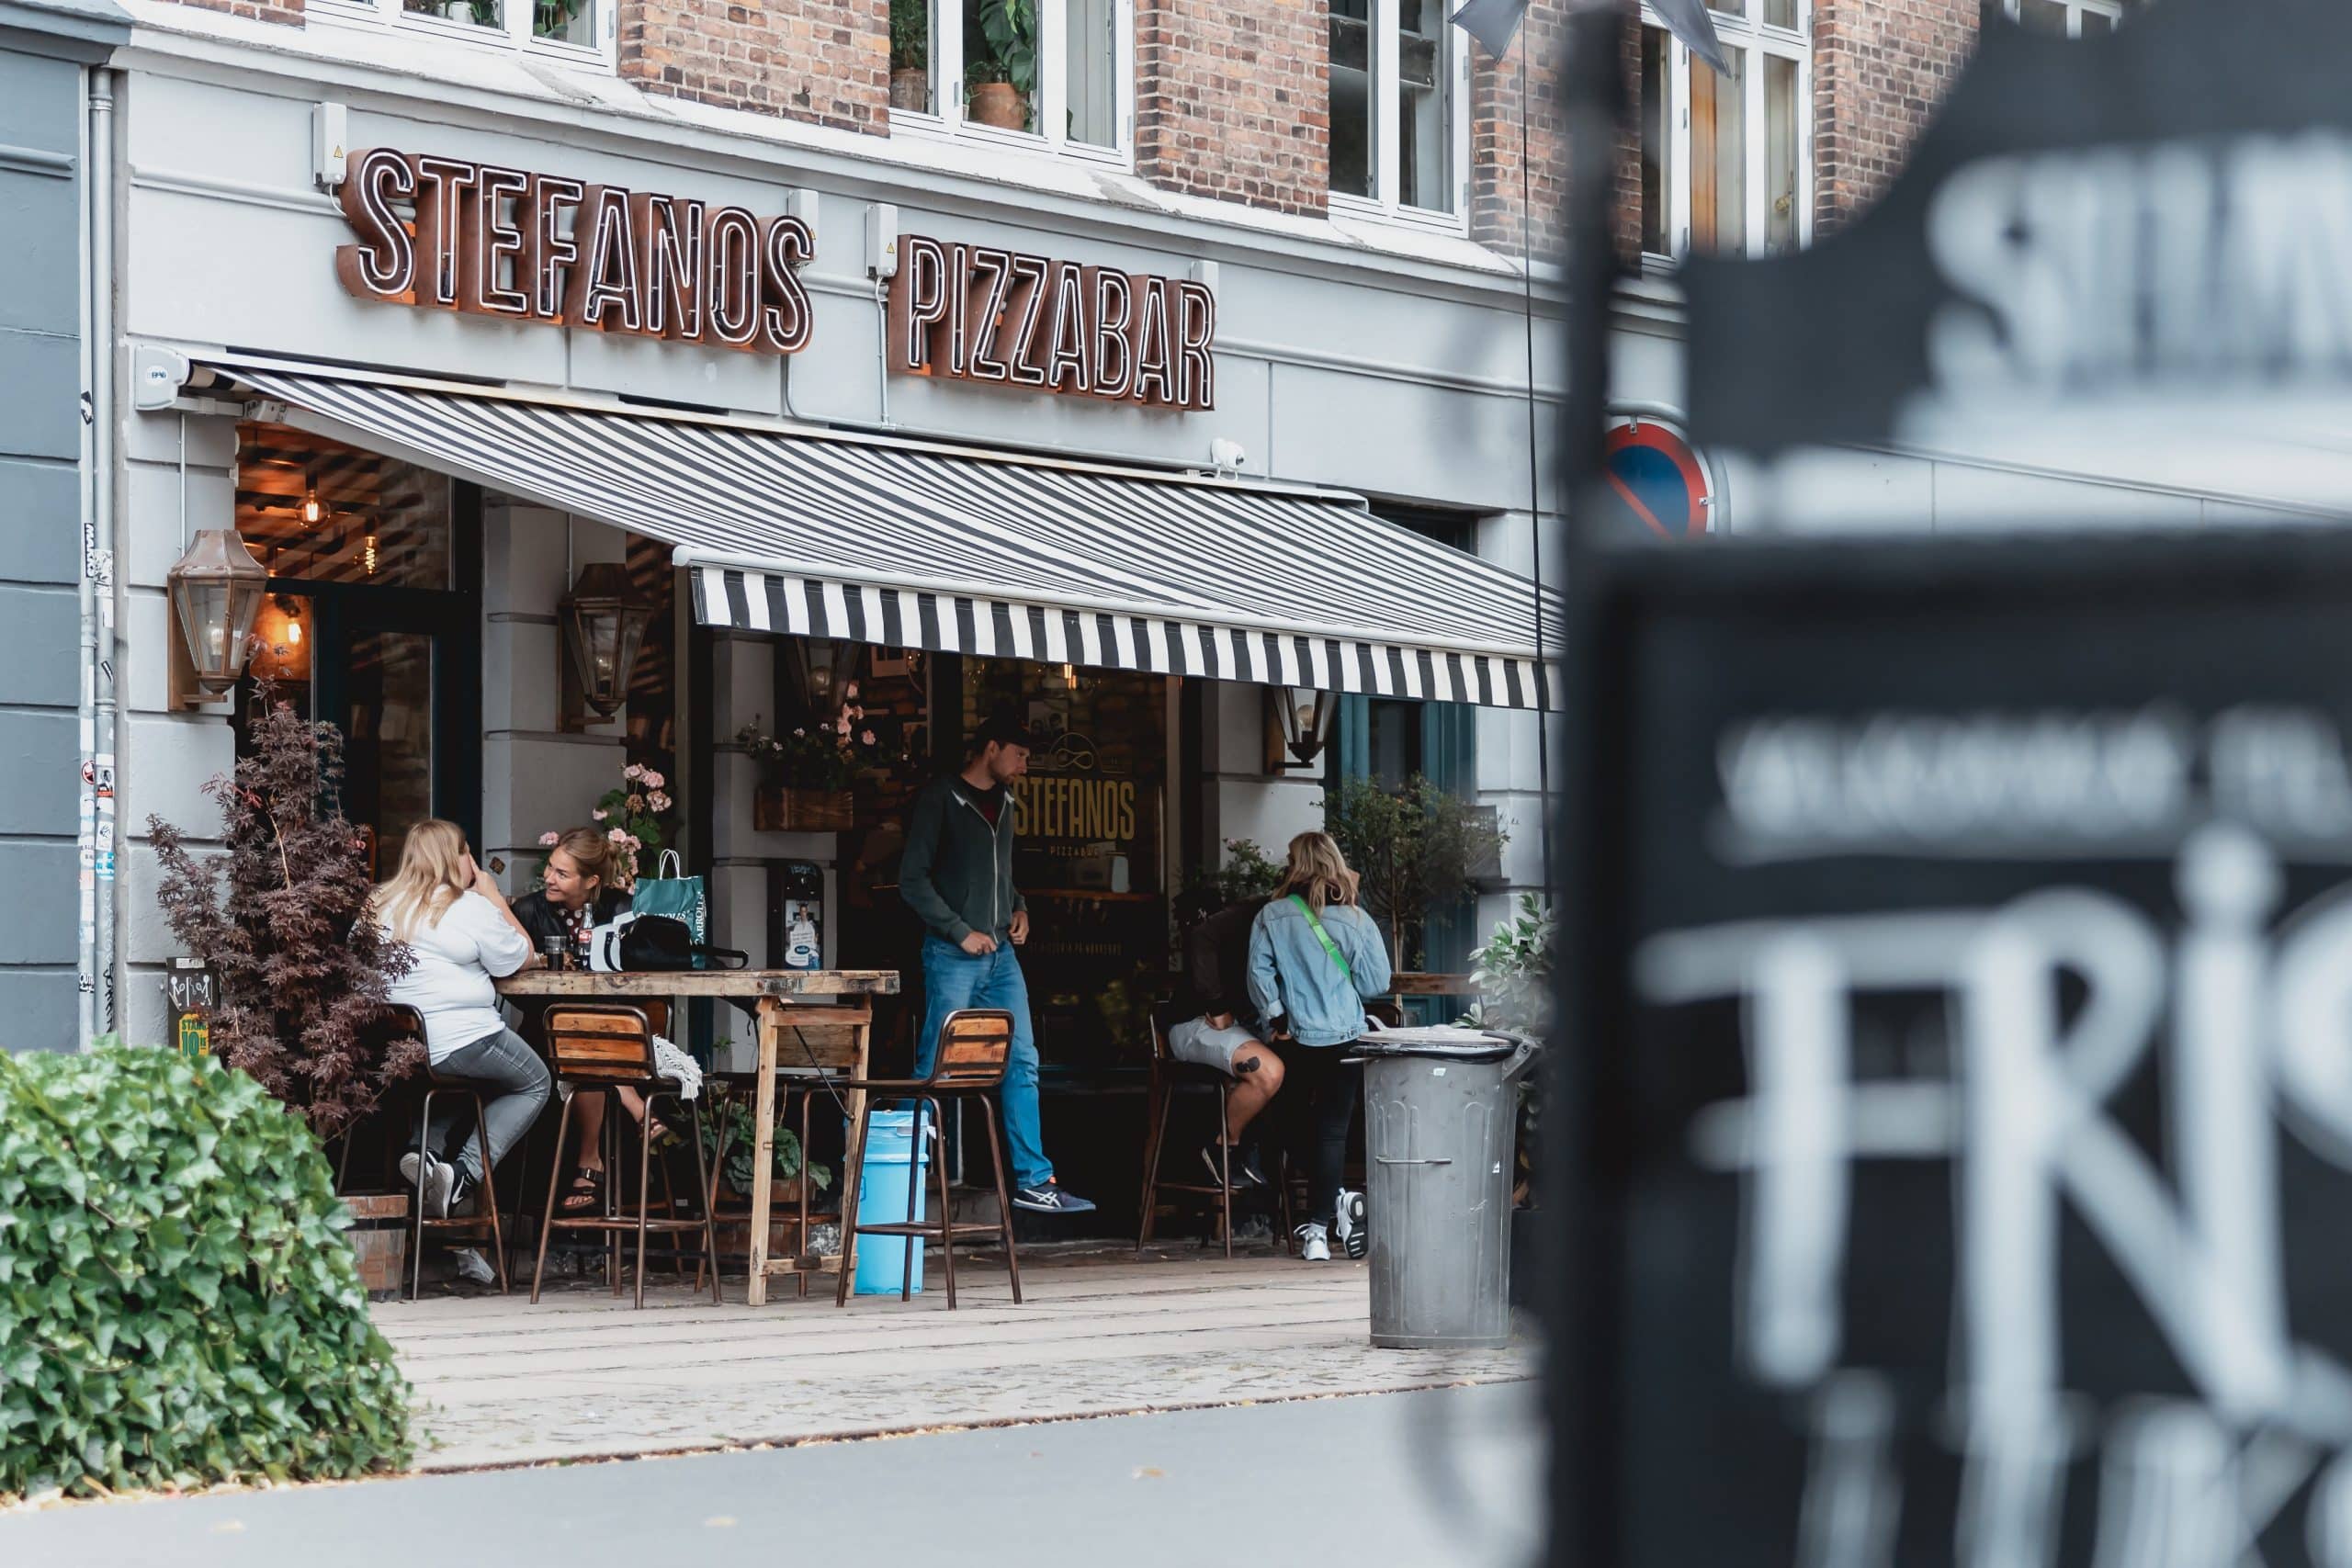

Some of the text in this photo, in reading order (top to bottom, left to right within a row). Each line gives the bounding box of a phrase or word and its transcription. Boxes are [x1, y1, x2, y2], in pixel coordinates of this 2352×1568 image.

[337, 147, 1216, 412] STEFANOS PIZZABAR
[1013, 776, 1136, 840] STEFANOS
